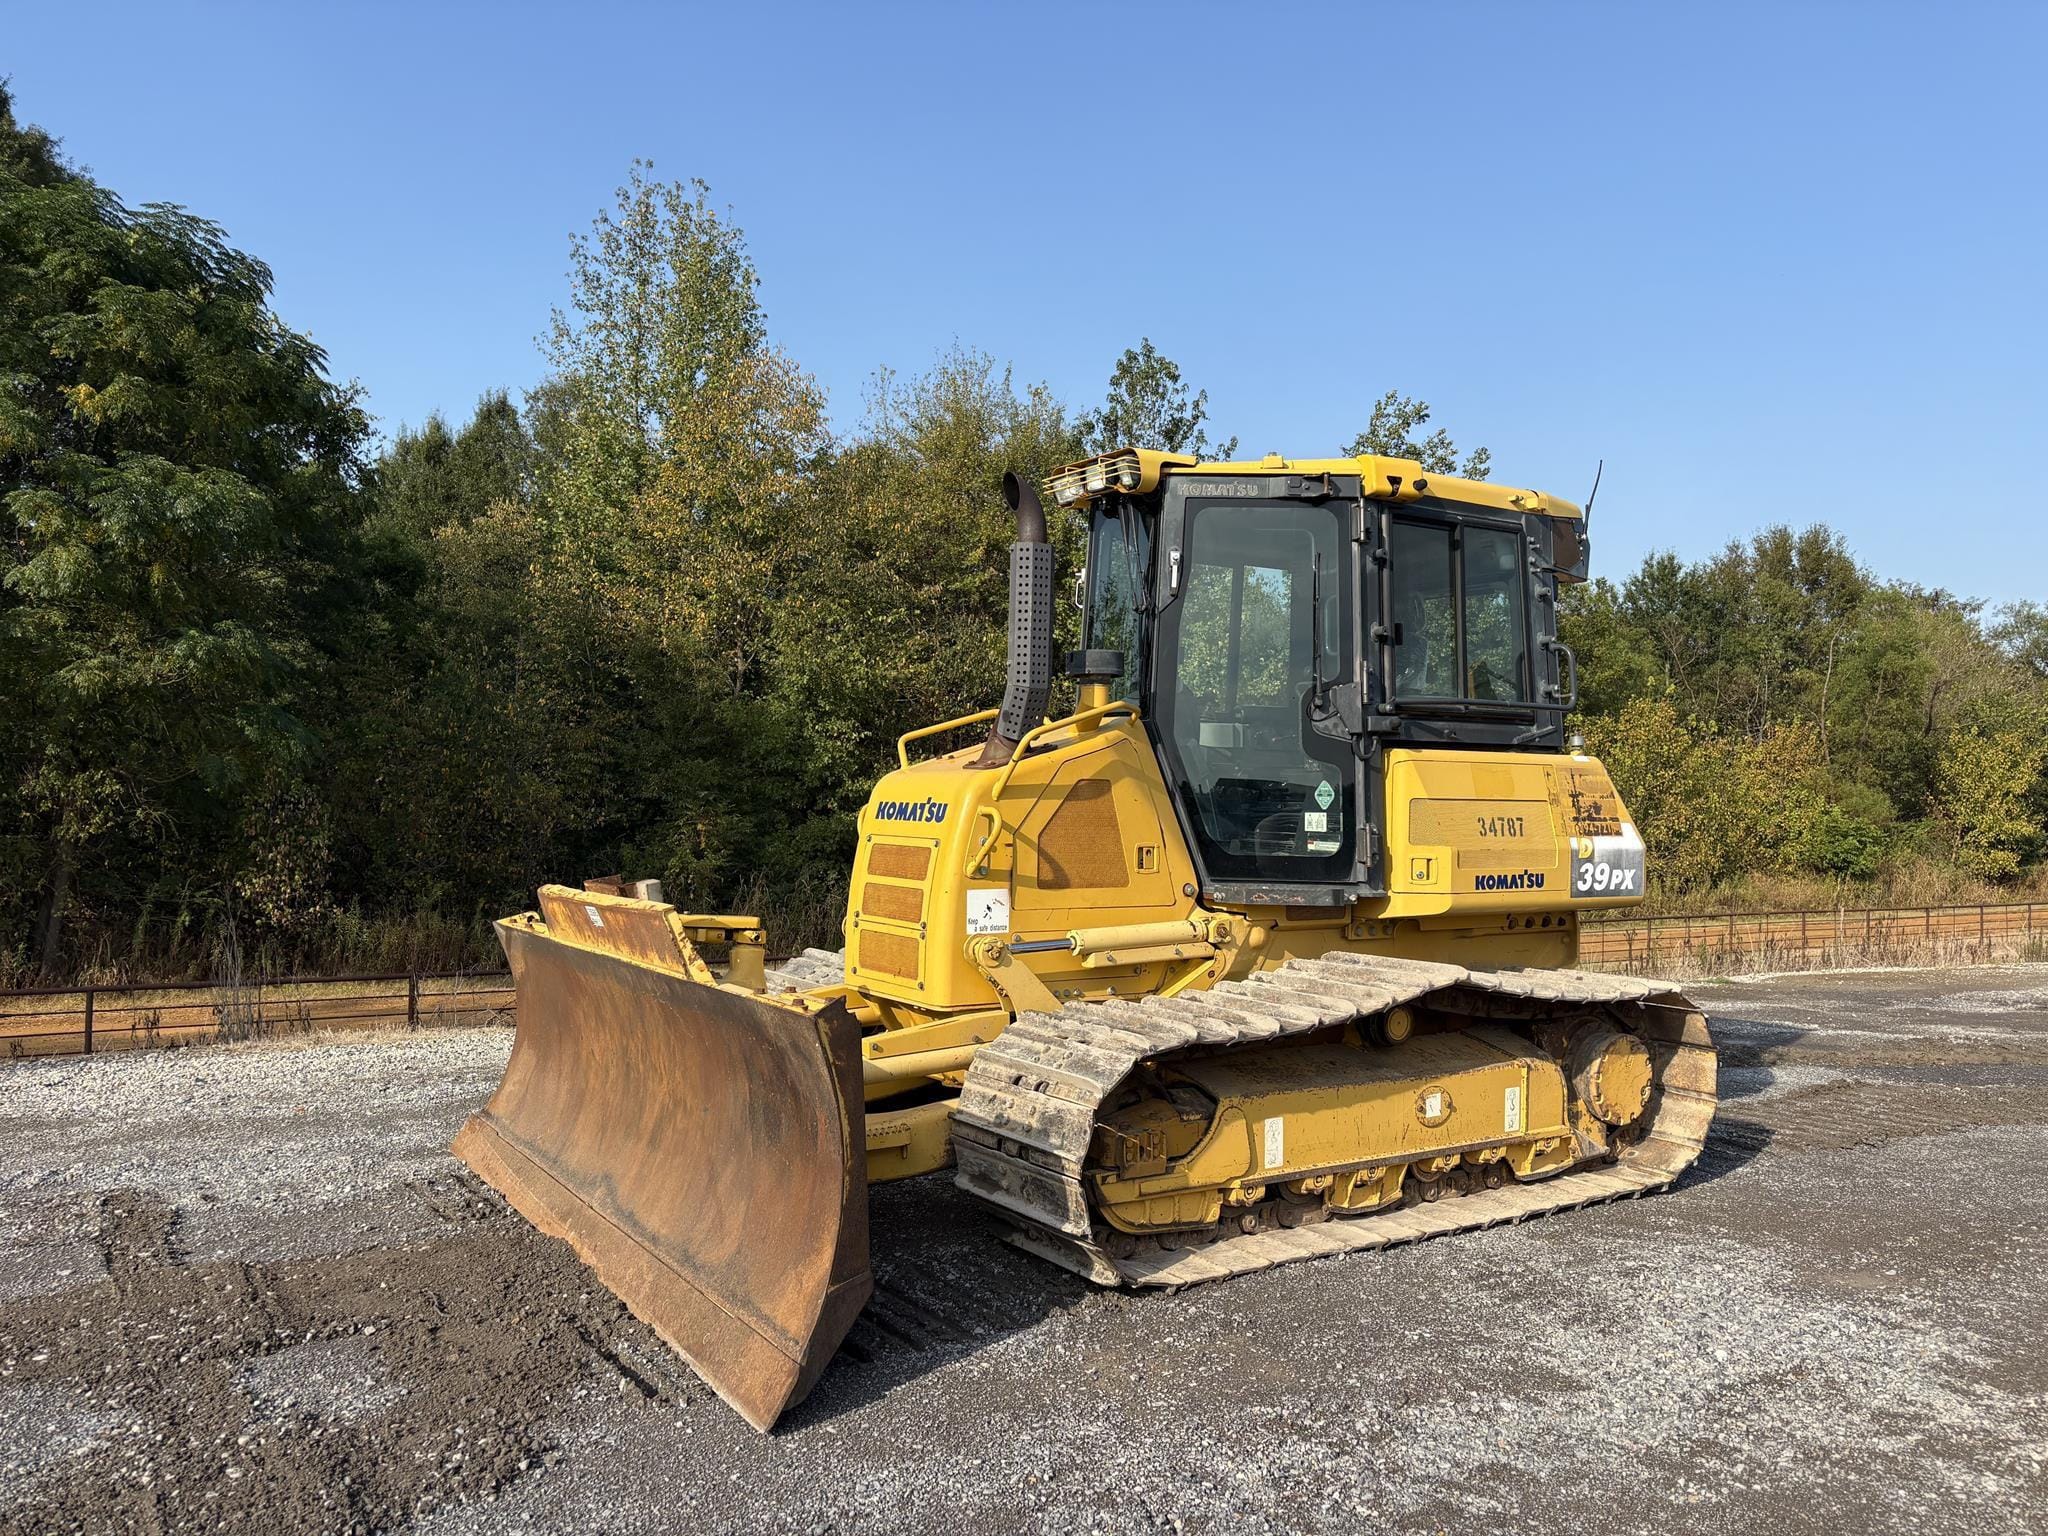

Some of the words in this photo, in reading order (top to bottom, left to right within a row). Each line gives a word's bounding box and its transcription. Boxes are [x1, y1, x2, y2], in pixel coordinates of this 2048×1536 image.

[875, 797, 949, 823] KOMATSU
[1477, 817, 1524, 837] 34787
[1578, 838, 1594, 859] D
[1474, 869, 1545, 891] KOMATSU
[1577, 862, 1636, 892] 39PX
